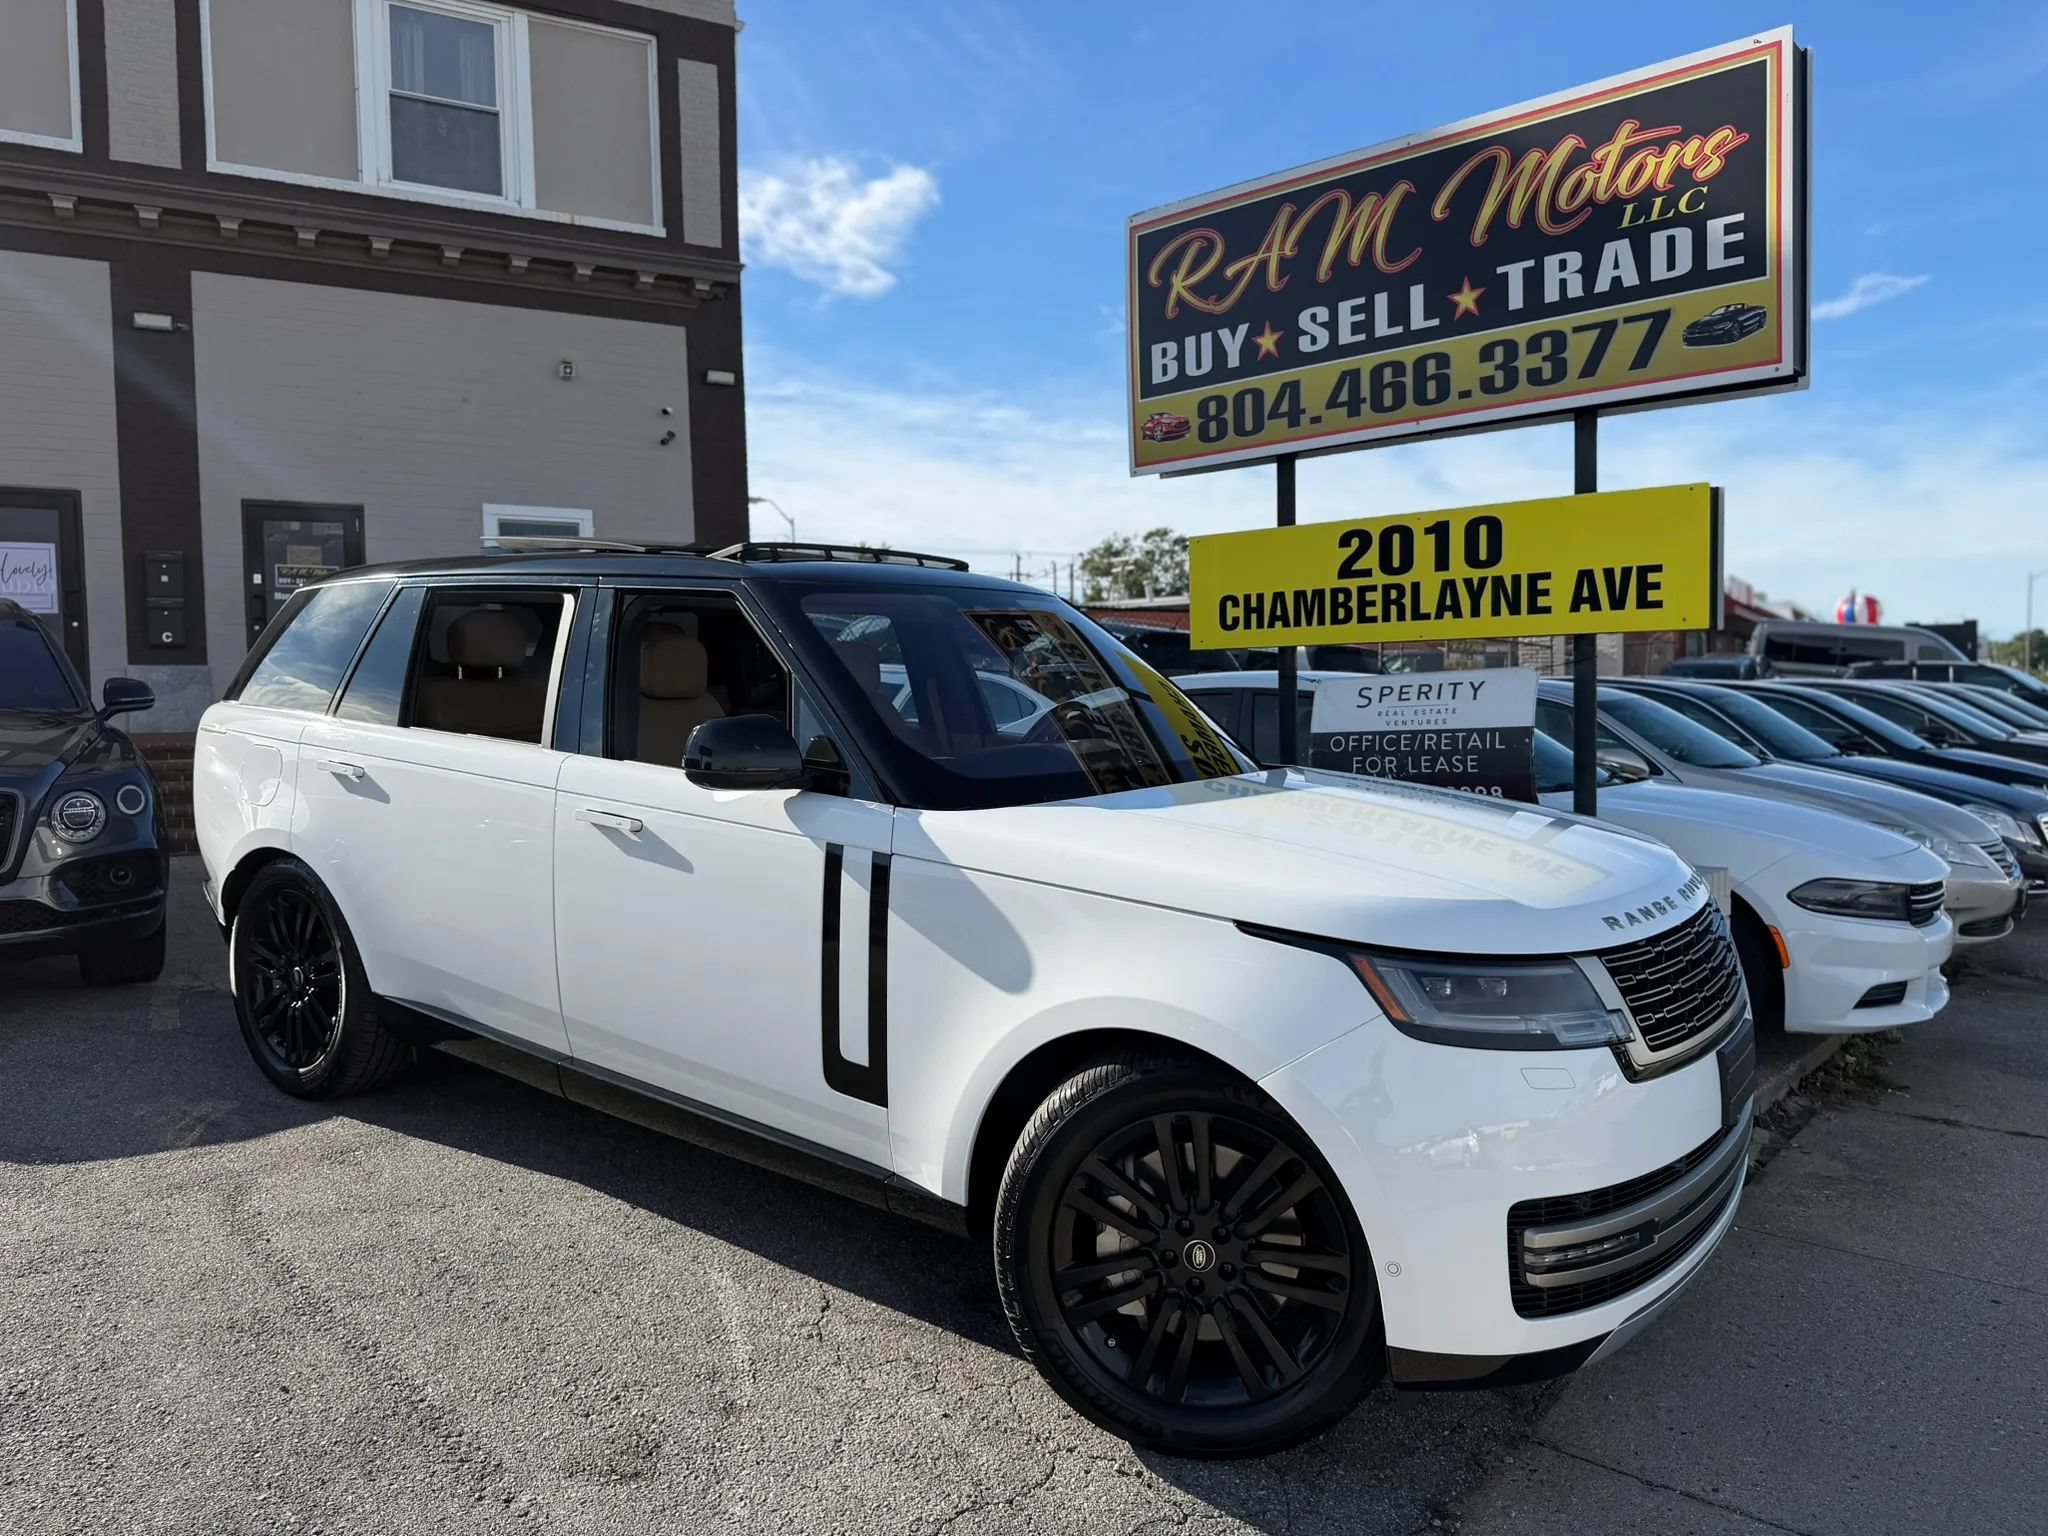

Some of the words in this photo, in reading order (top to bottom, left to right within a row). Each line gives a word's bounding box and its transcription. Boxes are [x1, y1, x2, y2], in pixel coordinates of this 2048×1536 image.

[1147, 179, 1423, 319] RAM
[1431, 119, 1749, 246] Motors
[1617, 186, 1709, 229] LLC
[1151, 323, 1250, 385] BUY
[1297, 284, 1440, 353] SELL
[1496, 212, 1746, 310] TRADE
[1196, 307, 1673, 444] 804.466.3377
[1337, 515, 1503, 580] 2010
[1218, 571, 1553, 632] CHAMBERLAYNE
[1568, 563, 1665, 613] AVE
[162, 631, 173, 643] C
[1356, 680, 1486, 709] SPERITY
[1414, 707, 1458, 716] ESTATE
[1385, 718, 1448, 727] VENTURES
[1330, 731, 1507, 752] OFFICE/RETAIL
[1352, 756, 1397, 774] FOR
[1408, 755, 1480, 773] LEASE
[1600, 895, 1679, 932] RANGE
